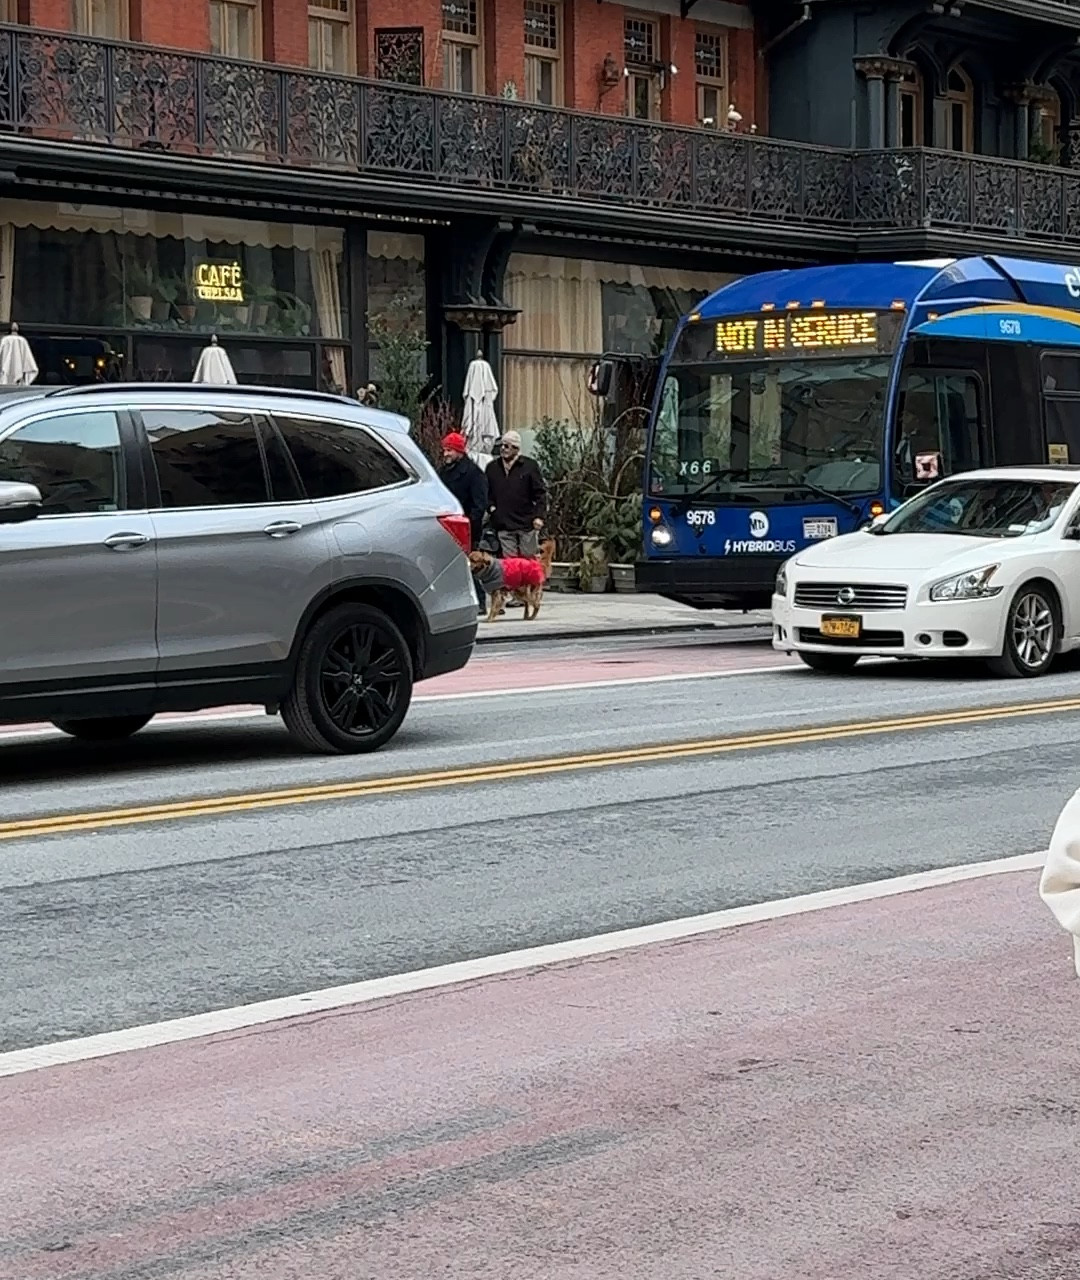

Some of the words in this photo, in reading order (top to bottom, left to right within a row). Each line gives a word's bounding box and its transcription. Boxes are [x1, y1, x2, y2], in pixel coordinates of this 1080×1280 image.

[199, 261, 241, 287] CAFÉ
[717, 321, 758, 351] NOT
[999, 320, 1021, 335] 9678
[687, 510, 716, 525] 9678
